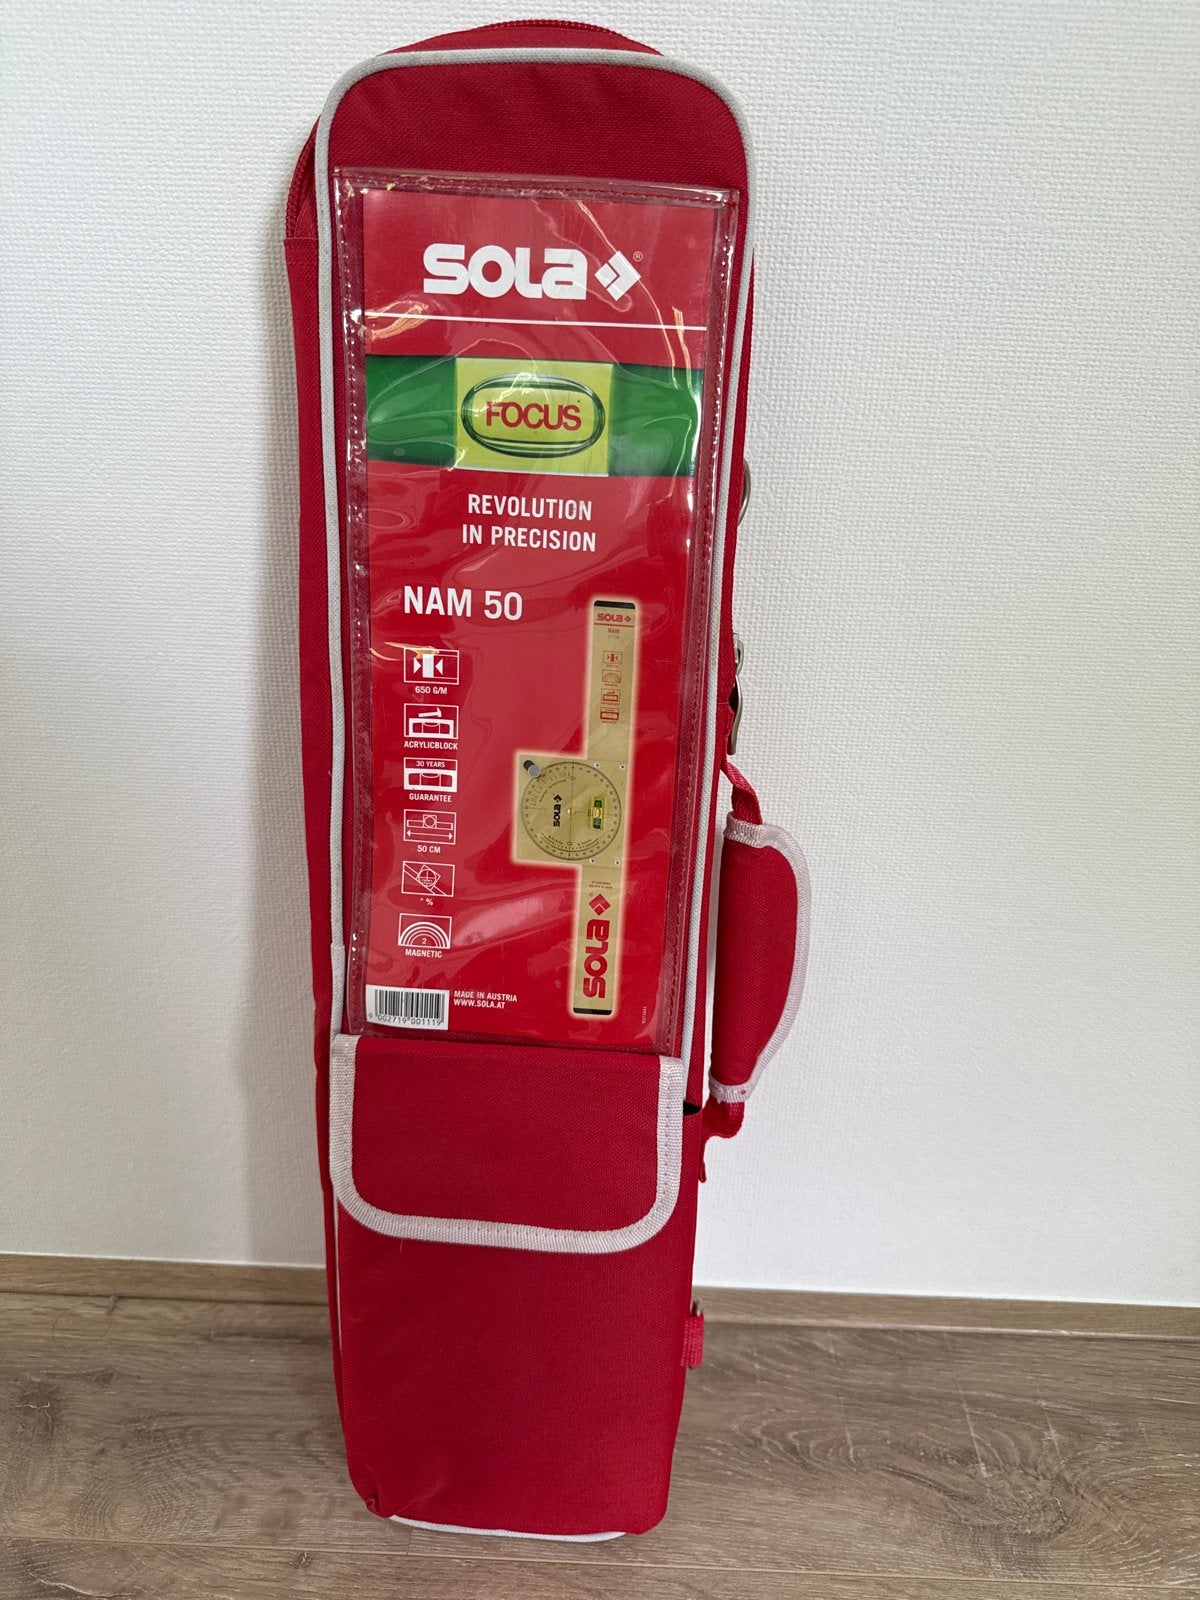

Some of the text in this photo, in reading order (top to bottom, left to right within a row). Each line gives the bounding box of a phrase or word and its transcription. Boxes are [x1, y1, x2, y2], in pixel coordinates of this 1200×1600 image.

[486, 401, 582, 431] FOCUS
[468, 494, 592, 521] REVOLUTION
[462, 524, 596, 552] IN PRECISION
[404, 585, 523, 621] NAM 50
[415, 686, 448, 695] 650 G/M
[404, 741, 458, 750] ACRYLICBLOCK
[409, 793, 452, 803] GUARANTEE
[417, 845, 441, 854] 50 CM
[405, 949, 442, 958] MAGNETIC
[454, 990, 518, 1002] MADE IN AUSTRIA
[453, 998, 506, 1009] WWW.SOLA.AT
[377, 1014, 407, 1024] 002719
[411, 1018, 441, 1026] 001119
